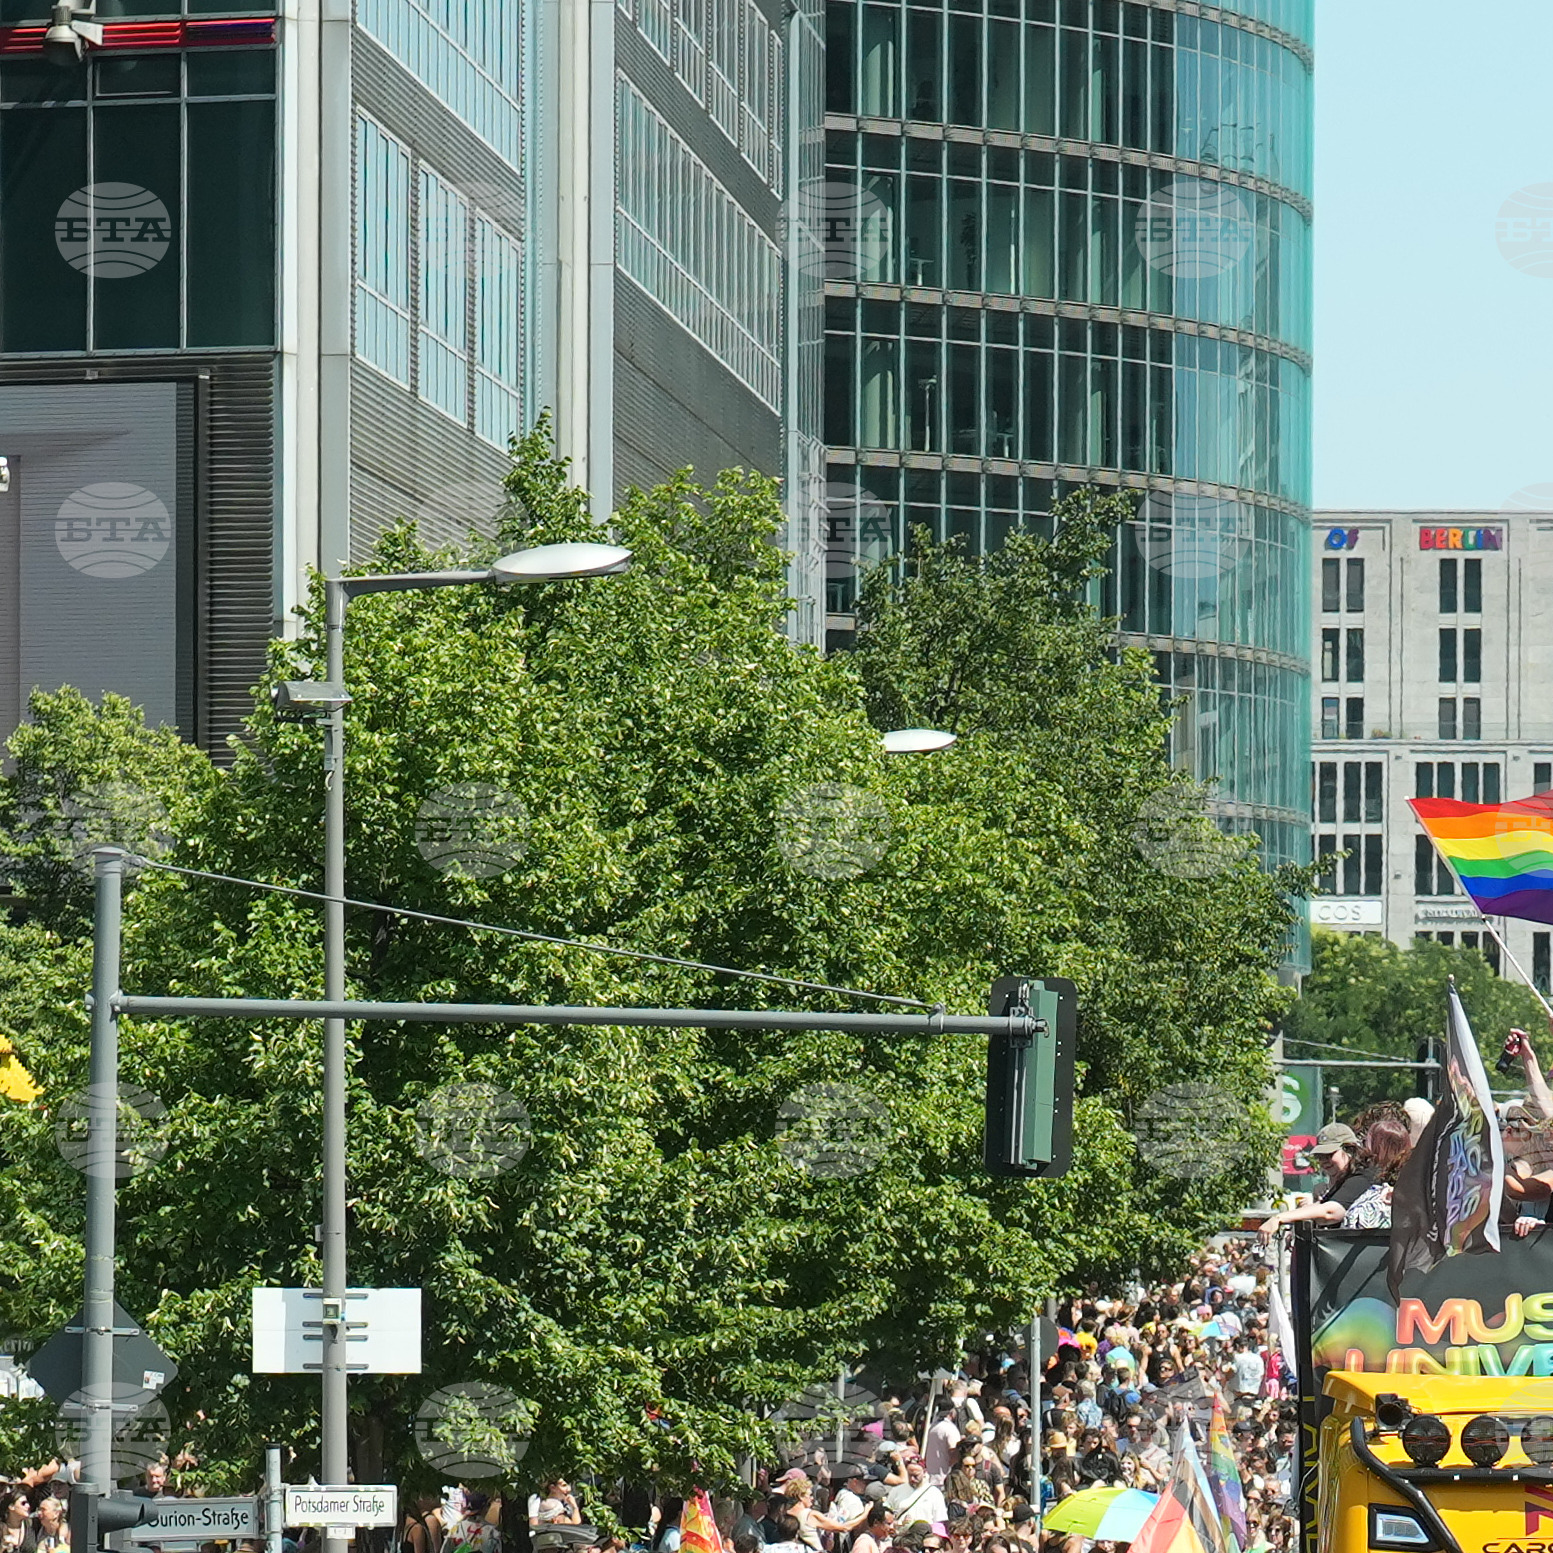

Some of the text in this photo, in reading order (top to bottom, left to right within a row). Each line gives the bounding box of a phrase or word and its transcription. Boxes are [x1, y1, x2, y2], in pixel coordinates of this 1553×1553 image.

[1326, 528, 1359, 550] OF
[1419, 528, 1503, 550] BERLIN
[1318, 905, 1361, 921] COS
[294, 1495, 386, 1517] Potsdamer Straße
